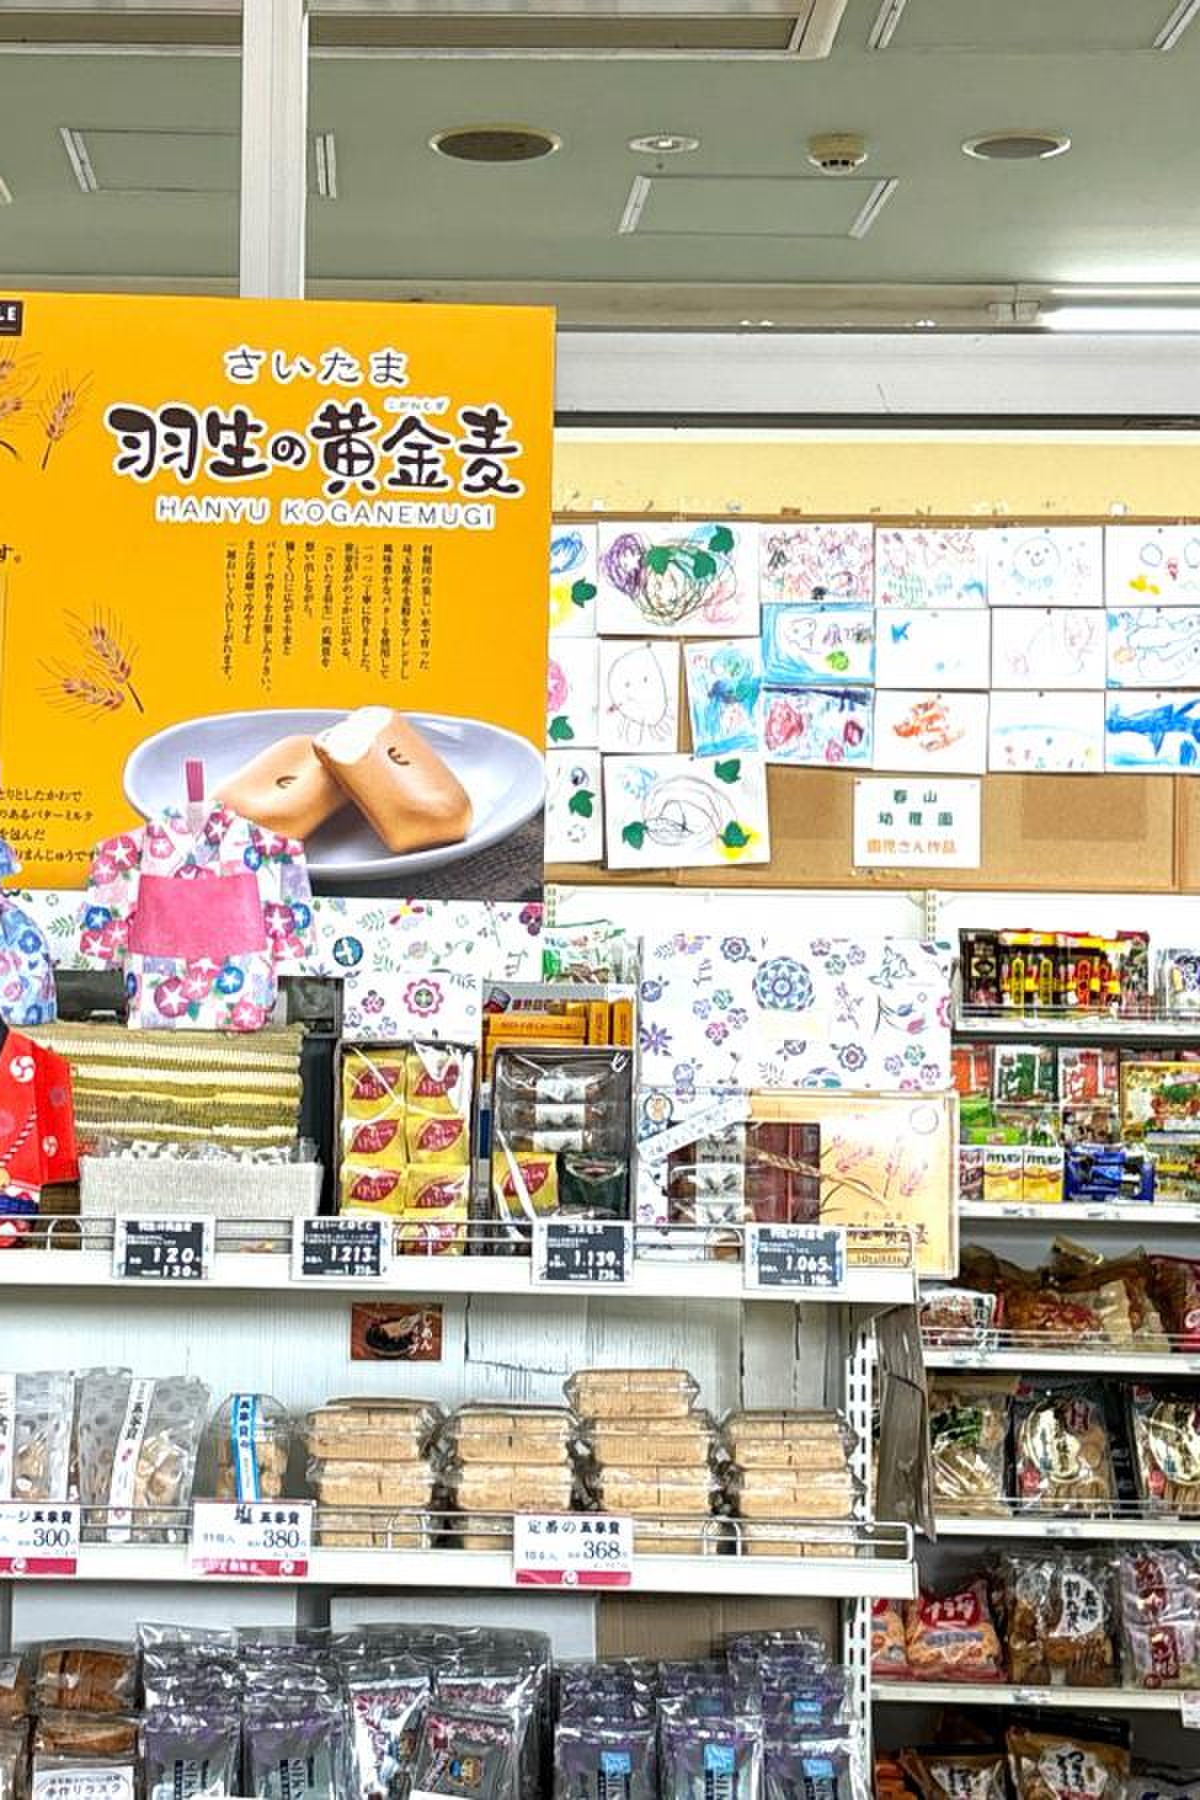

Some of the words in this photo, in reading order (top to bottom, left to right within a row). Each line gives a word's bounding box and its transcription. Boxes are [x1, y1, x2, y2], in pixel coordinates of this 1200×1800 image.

[227, 349, 405, 384] さいたま
[108, 402, 520, 495] 羽生の黄金麦
[159, 499, 267, 520] HANYU
[284, 503, 494, 526] KOGANEMUGI
[33, 1528, 70, 1547] 300
[263, 1529, 300, 1548] 380
[583, 1540, 621, 1559] 368
